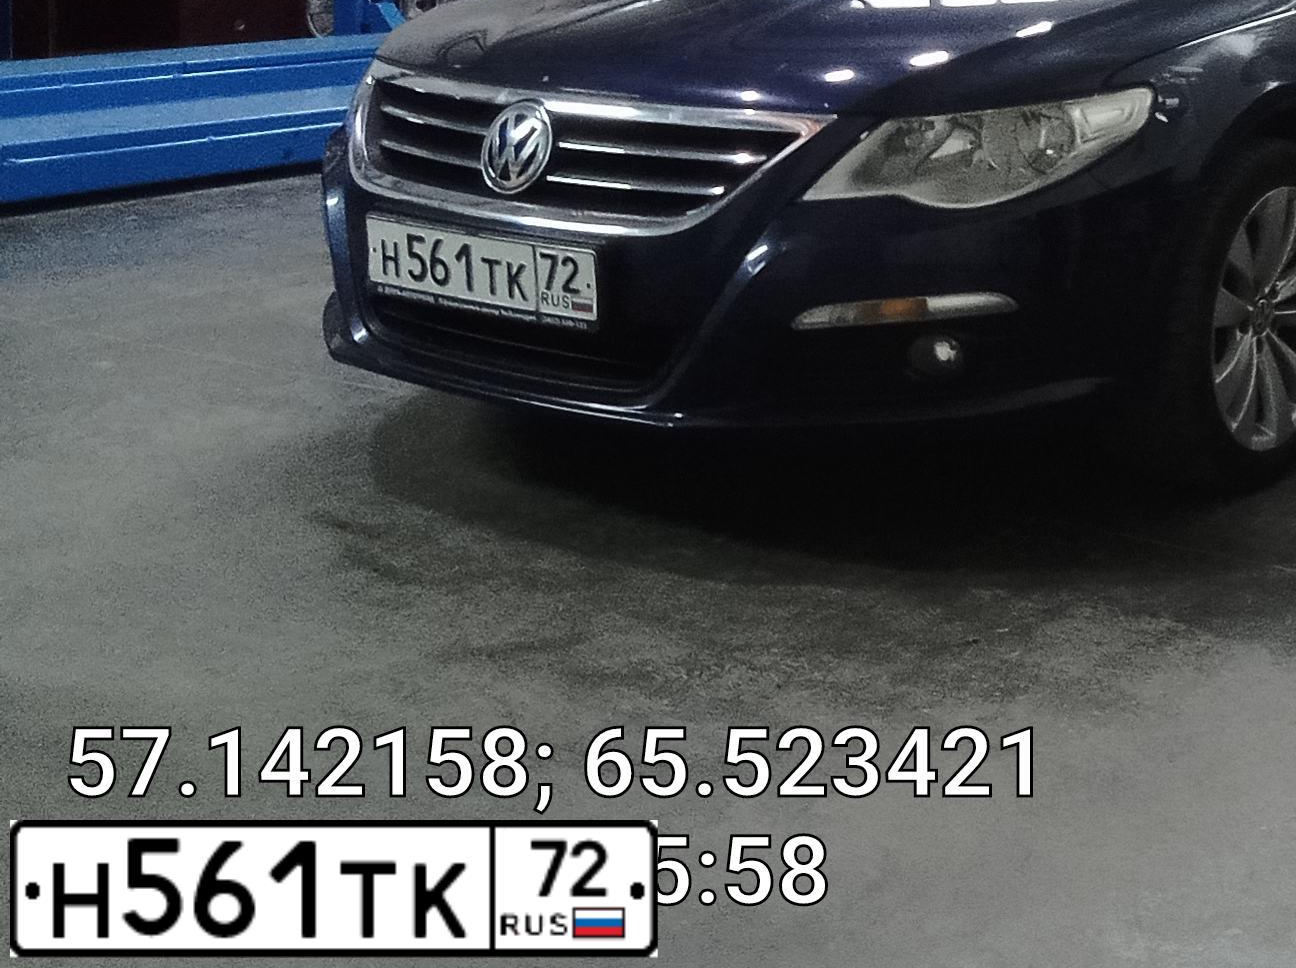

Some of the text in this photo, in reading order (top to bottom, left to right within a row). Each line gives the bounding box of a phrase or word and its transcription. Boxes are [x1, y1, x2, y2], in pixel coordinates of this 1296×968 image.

[380, 233, 581, 302] Н561ТК 72
[540, 291, 571, 309] RUS
